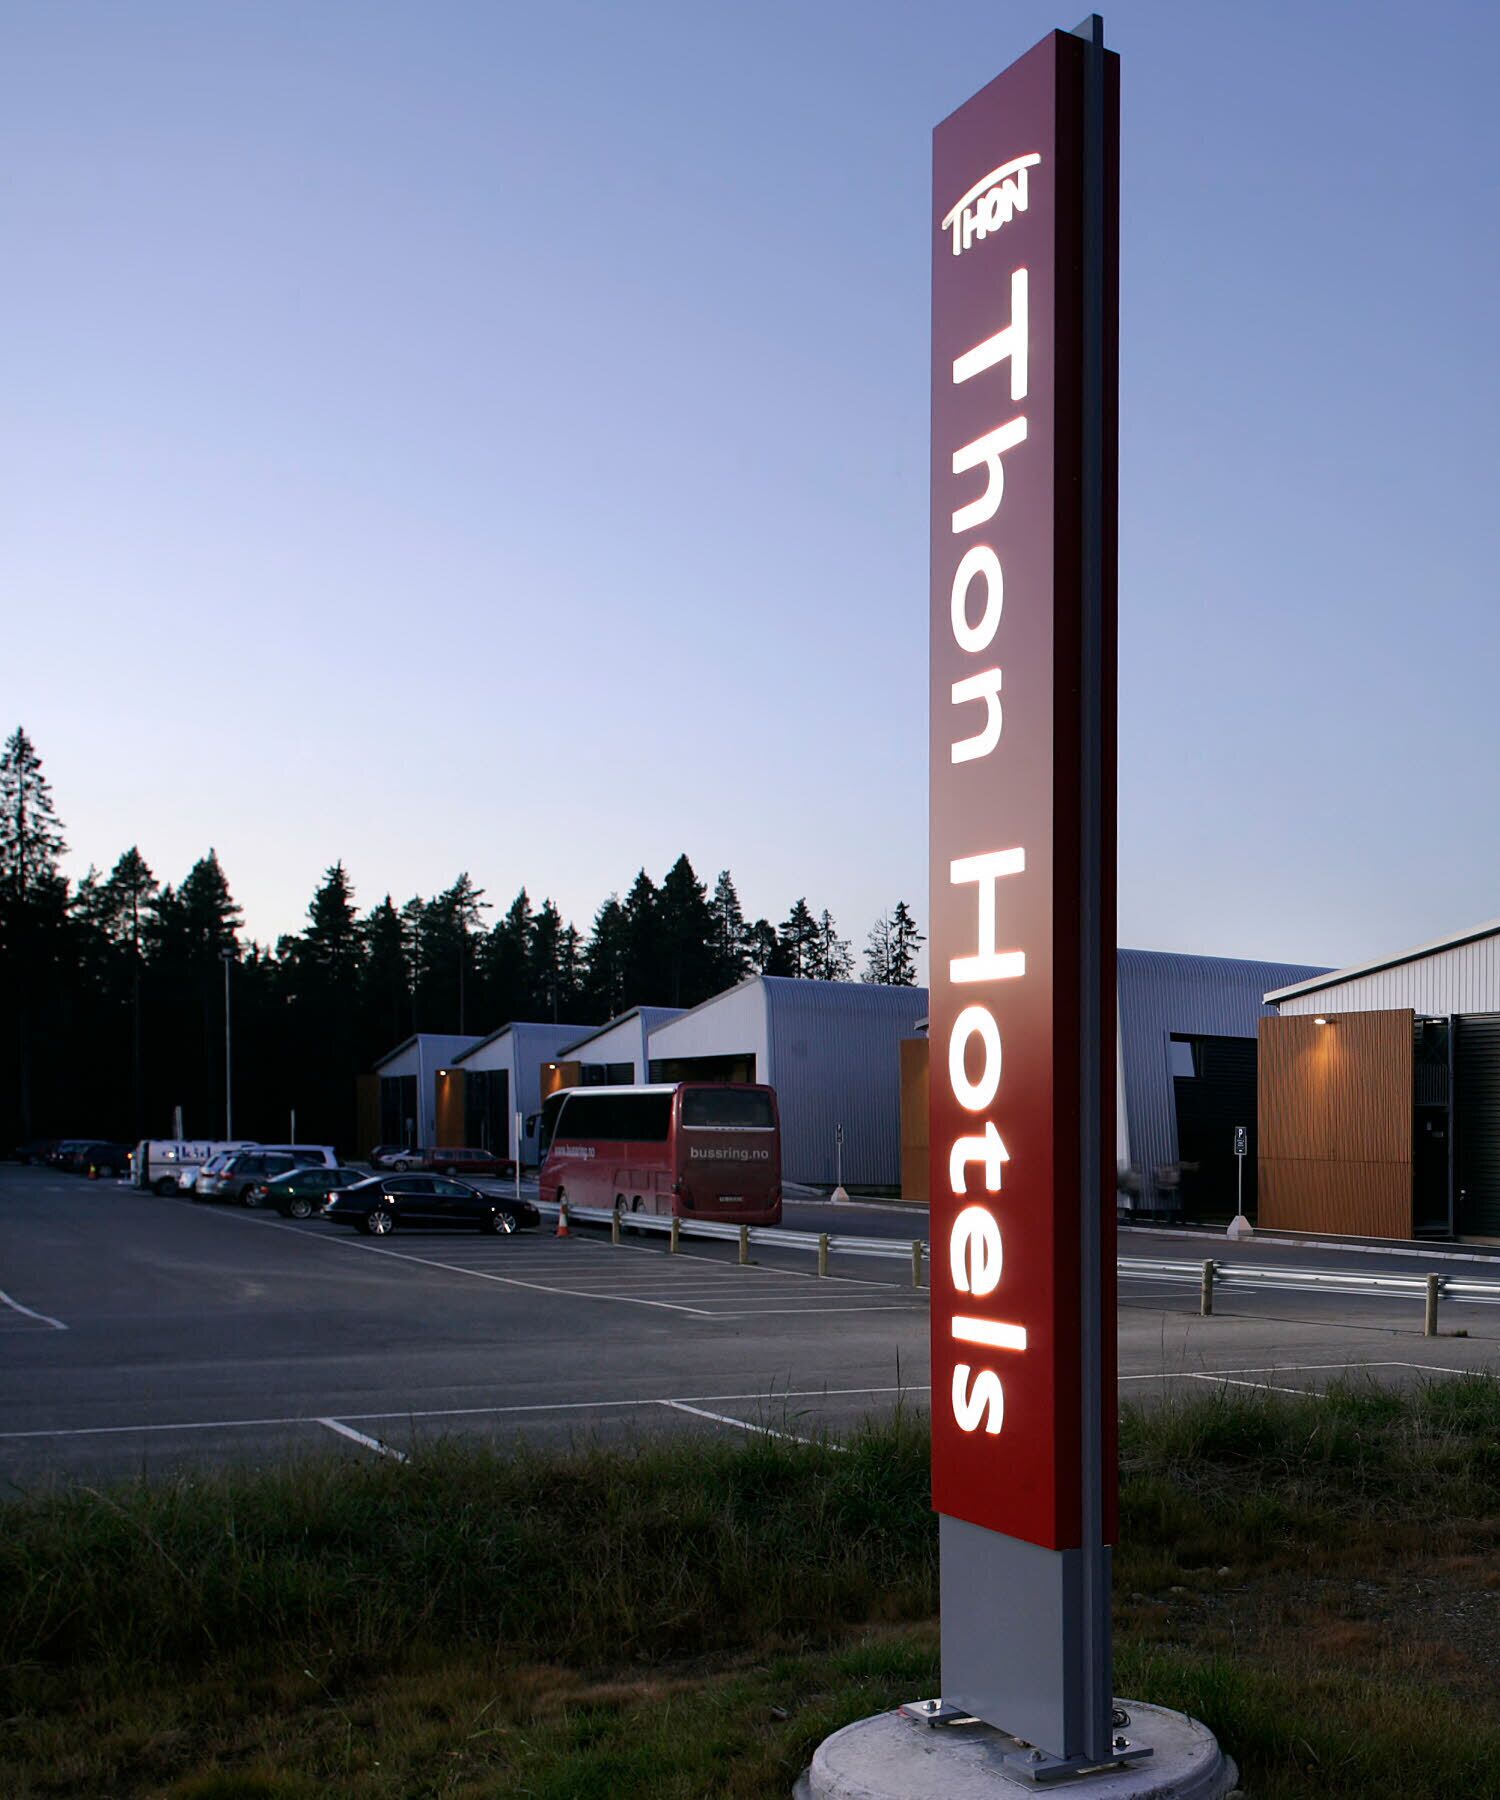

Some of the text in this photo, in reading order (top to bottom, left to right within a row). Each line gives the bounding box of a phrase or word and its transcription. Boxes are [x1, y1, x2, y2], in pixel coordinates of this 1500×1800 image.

[942, 153, 1041, 255] THON
[949, 268, 1028, 1435] Thon Hotels
[690, 1146, 769, 1161] bussring.no
